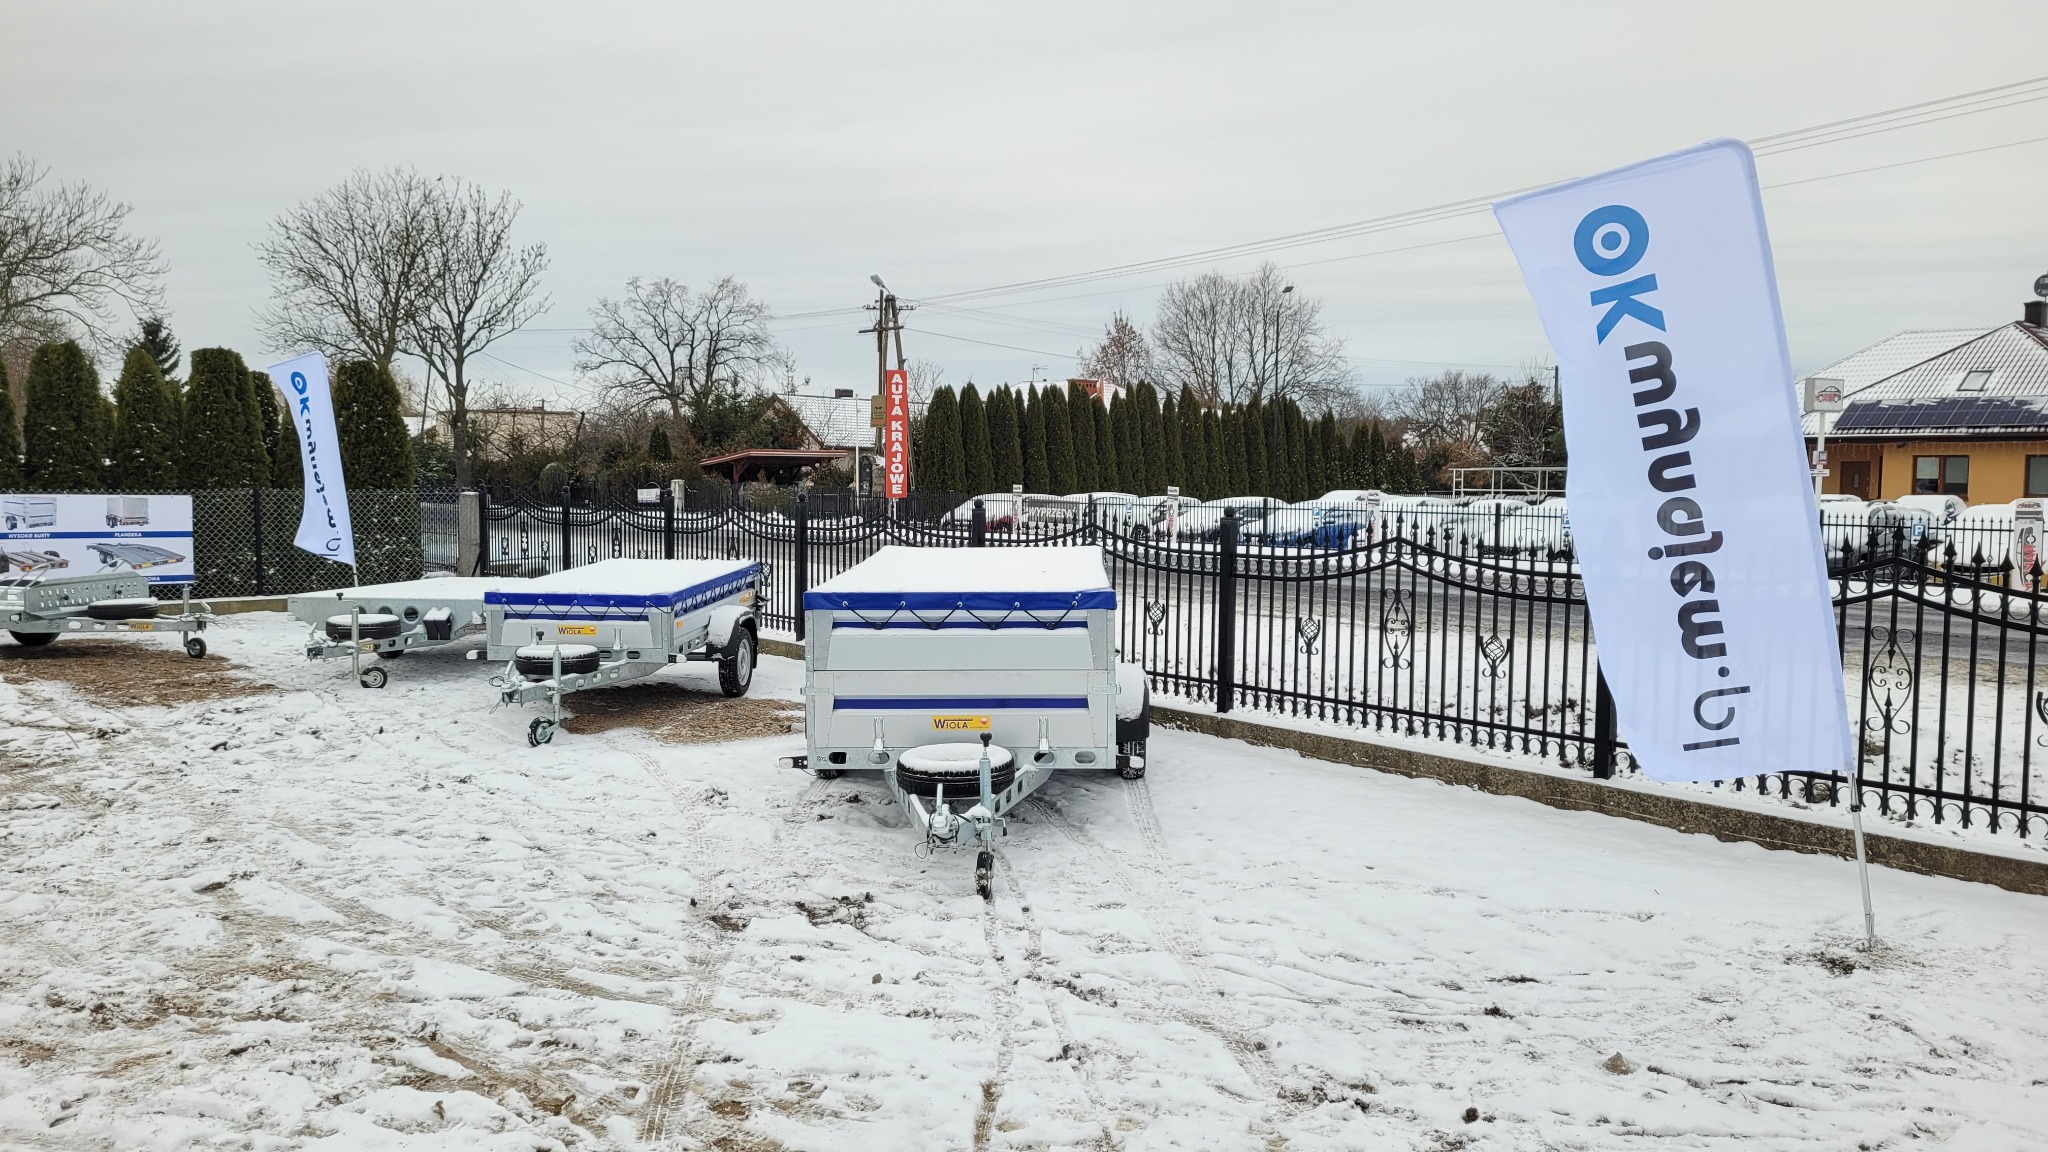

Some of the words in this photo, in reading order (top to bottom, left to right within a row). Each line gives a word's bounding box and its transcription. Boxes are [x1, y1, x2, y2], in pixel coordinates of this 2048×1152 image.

[891, 373, 903, 416] AUTA
[889, 420, 905, 494] KRAJOWE
[558, 626, 582, 635] WIOLA
[933, 718, 969, 729] WIOLA
